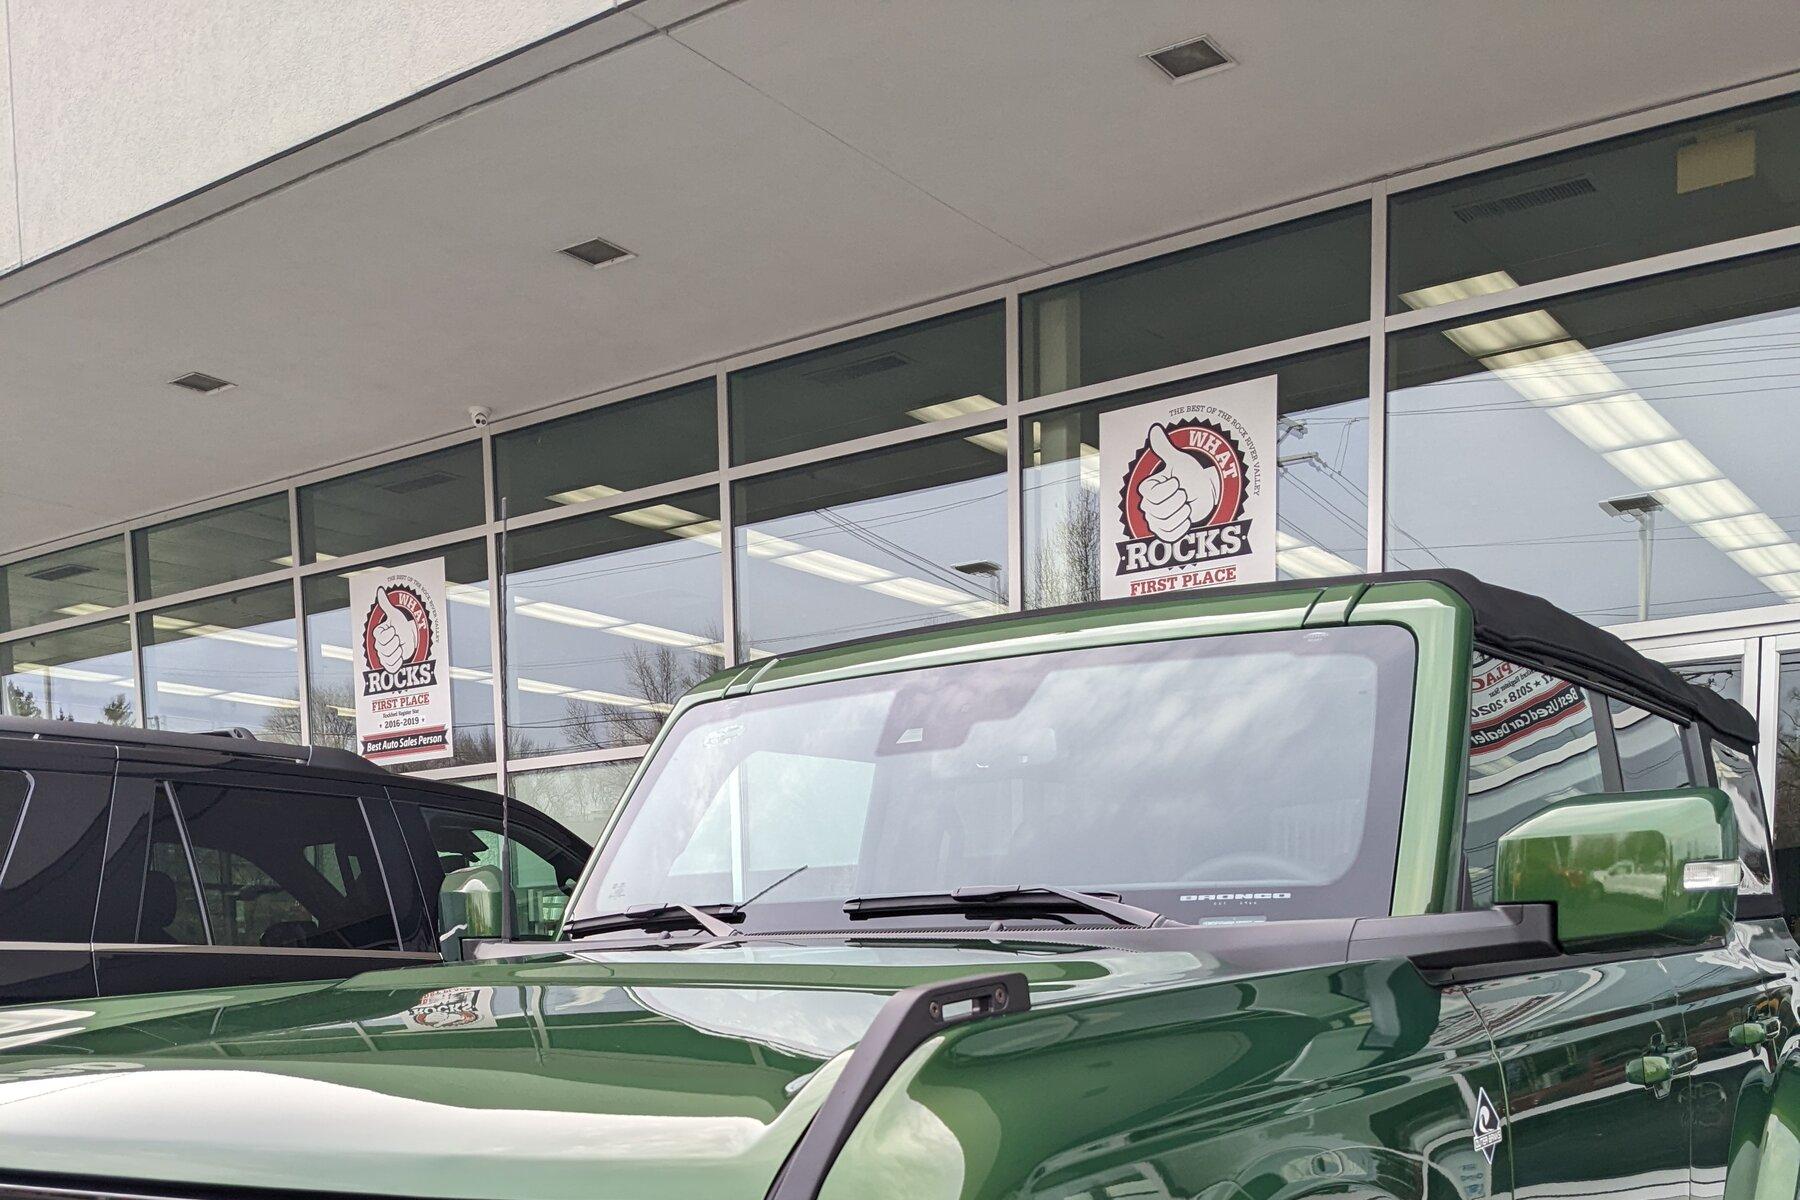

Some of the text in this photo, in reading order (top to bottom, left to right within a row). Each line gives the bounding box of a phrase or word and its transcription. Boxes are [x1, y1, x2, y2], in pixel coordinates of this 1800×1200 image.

[1169, 405, 1261, 496] THE BEST OF THE ROCK RIVER VALLEY
[1189, 430, 1238, 479] WHAT
[1125, 525, 1242, 571] ROCKS
[1130, 568, 1237, 597] FIRST PLACE
[398, 592, 426, 631] WHAT
[368, 663, 432, 693] ROCKS
[372, 693, 430, 711] FIRST PLACE
[384, 717, 420, 729] 2016-2019
[366, 734, 443, 752] Best Auto Sales Person
